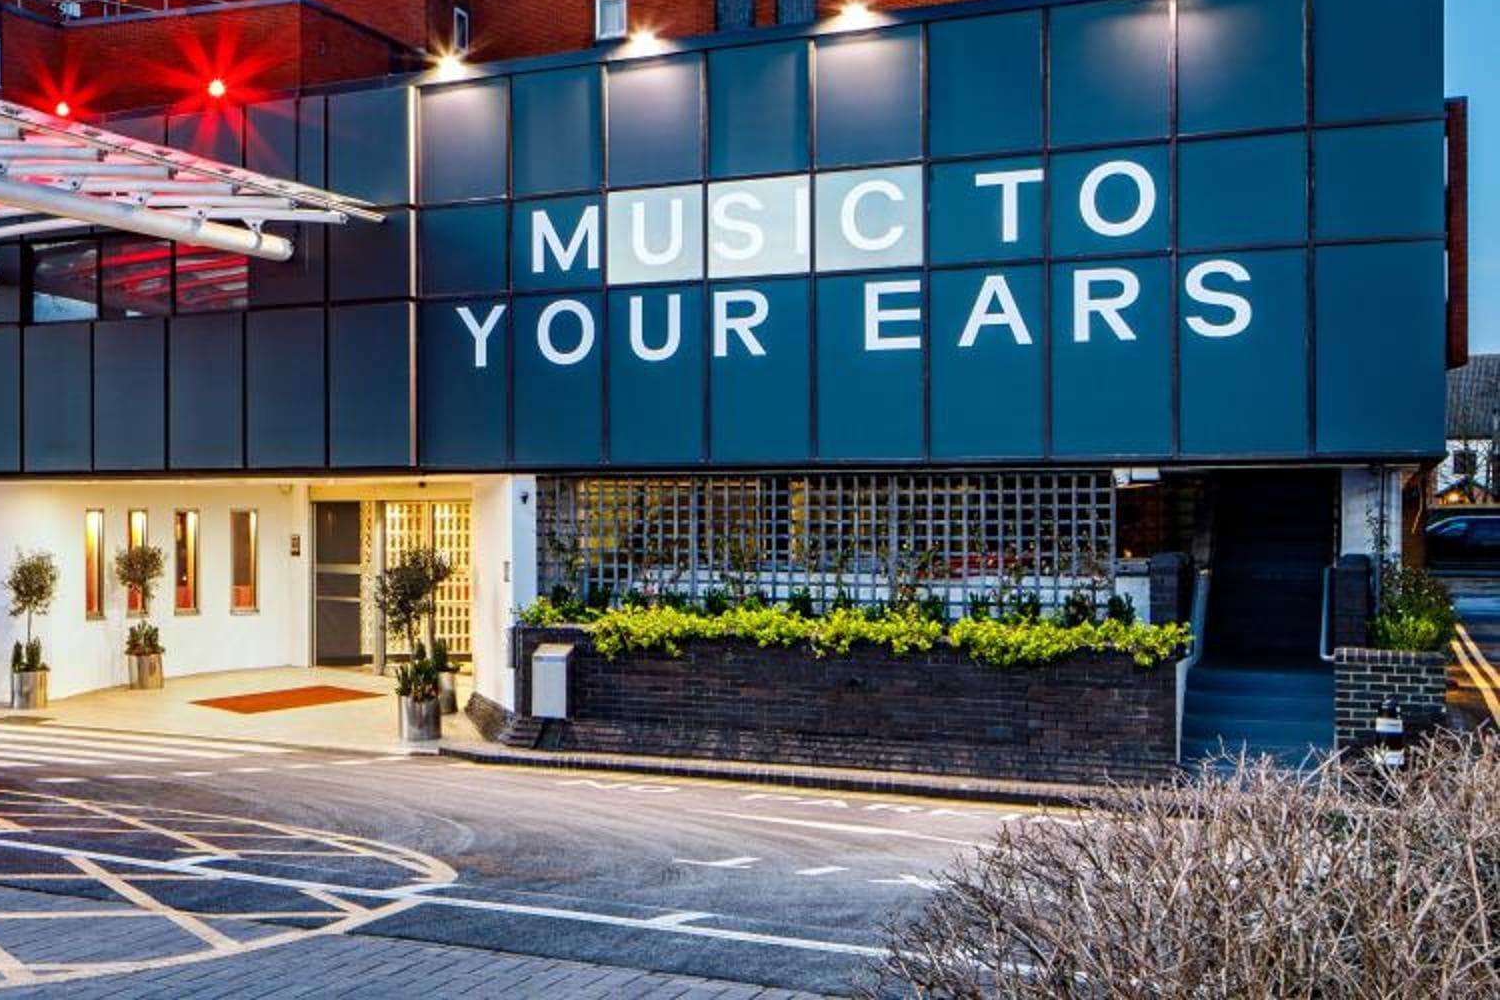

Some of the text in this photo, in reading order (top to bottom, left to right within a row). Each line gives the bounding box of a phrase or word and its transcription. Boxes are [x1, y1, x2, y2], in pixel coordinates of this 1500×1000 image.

[531, 160, 1158, 273] MUSIC TO
[455, 259, 1254, 369] YOUR EARS
[554, 779, 680, 793] NO
